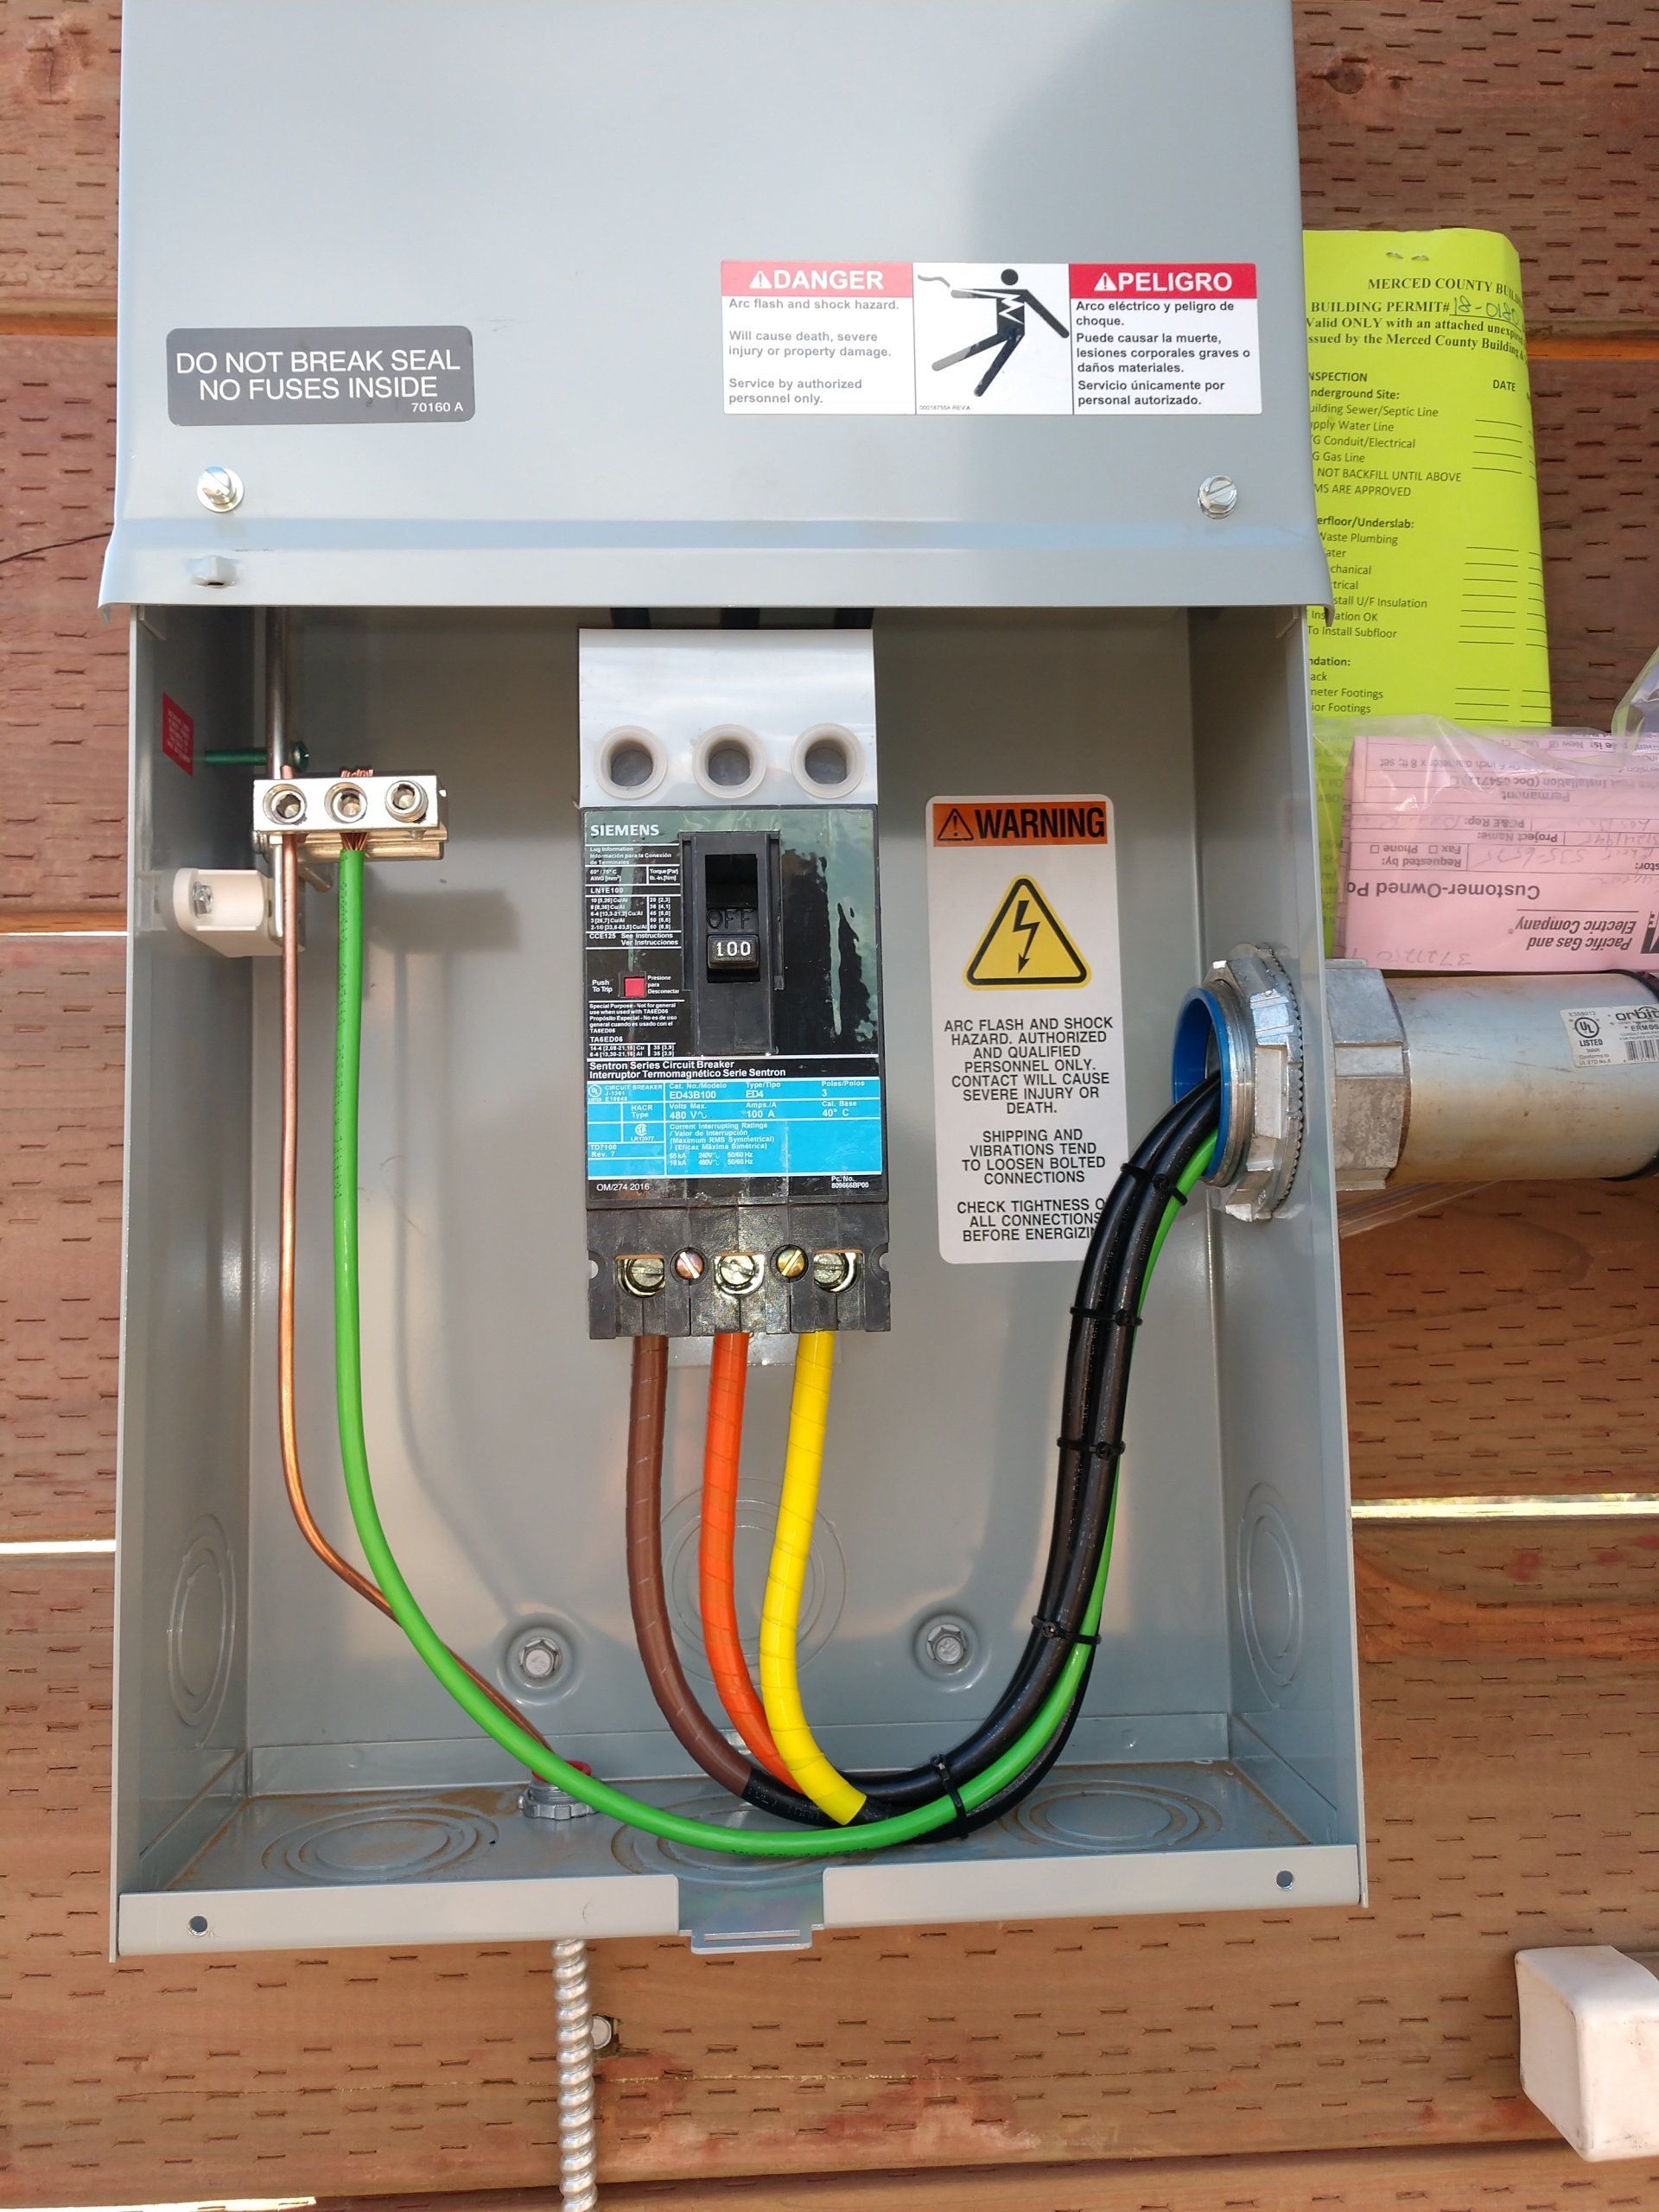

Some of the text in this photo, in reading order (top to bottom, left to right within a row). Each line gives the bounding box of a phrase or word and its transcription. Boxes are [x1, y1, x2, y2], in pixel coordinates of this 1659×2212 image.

[774, 270, 884, 290] DANGER
[1118, 272, 1233, 291] PELIGRO
[1368, 277, 1492, 293] MERCED COUNTY
[728, 298, 899, 310] Arc flash and shock hazard.
[1076, 301, 1234, 314] Arco eléctrico y peligro de
[1311, 302, 1450, 313] BUILDING PERMIT#
[1076, 316, 1124, 328] choque.
[1306, 317, 1338, 328] Valid
[1341, 317, 1382, 327] ONLY
[1386, 317, 1413, 328] with
[1417, 321, 1431, 329] an
[1435, 319, 1484, 332] attached
[729, 331, 878, 343] Will cause death, severe
[1076, 334, 1222, 345] Puede causar la muerte,
[728, 346, 763, 358] injury
[784, 346, 836, 359] property
[839, 346, 892, 359] damage.
[1308, 334, 1519, 358] ssued by the Merced County Building
[1077, 348, 1127, 358] lesiones
[1130, 348, 1195, 360] corporales
[1198, 350, 1238, 360] graves
[175, 349, 461, 373] DO NOT BREAK SEAL
[1077, 362, 1184, 372] daños materiales.
[200, 376, 438, 400] NO FUSES INSIDE
[728, 378, 862, 391] Service by authorized
[1077, 380, 1225, 392] Servicio únicamente por
[1492, 379, 1516, 391] DATE
[728, 394, 823, 406] personnel only.
[1077, 395, 1202, 407] personal autorizado.
[1311, 388, 1400, 402] nderground Site:
[411, 402, 464, 413] 70160 A
[1346, 404, 1439, 417] Sewer/Septic Line
[1338, 420, 1395, 432] Water Line
[1324, 435, 1415, 449] Conduit/Electrical
[1323, 452, 1365, 463] Gas Line
[1317, 467, 1462, 482] NOT BACKFILL UNTIL ABOVE
[1332, 484, 1351, 494] ARE
[1355, 485, 1411, 497] APPROVED
[1351, 533, 1398, 546] Plumbing
[1377, 598, 1427, 608] Insulation
[1363, 612, 1378, 621] OK
[1307, 625, 1397, 639] To Install Subfloor
[1341, 688, 1383, 701] Footings
[590, 824, 660, 836] SIEMENS
[975, 808, 1105, 839] WARNING
[1478, 831, 1558, 843] Project Name:
[1382, 843, 1462, 855] Fax Phone
[1382, 855, 1462, 868] Requested by:
[1376, 882, 1541, 900] Customer-Owned
[706, 908, 754, 930] OFF
[1516, 916, 1637, 935] Electric Company
[716, 941, 751, 957] 100
[1527, 937, 1633, 951] Pacific Gas and
[944, 1016, 1114, 1032] ARC FLASH AND SHOCK
[951, 1031, 1107, 1046] HAZARD. AUTHORIZED
[973, 1046, 1081, 1059] AND QUALIFIED
[589, 1062, 628, 1071] Sentron
[630, 1062, 660, 1071] Series
[696, 1060, 734, 1069] Breaker
[964, 1059, 1096, 1073] PERSONNEL ONLY.
[589, 1071, 640, 1080] Interruptor
[642, 1069, 721, 1080] Termomagnético
[951, 1072, 1109, 1087] CONTACT WILL CAUSE
[963, 1086, 1099, 1101] SEVERE INJURY OR
[1007, 1102, 1057, 1114] DEATH.
[982, 1128, 1083, 1142] SHIPPING AND
[969, 1142, 1096, 1157] VIBRATIONS TEND
[962, 1156, 1105, 1172] TO LOOSEN BOLTED
[984, 1171, 1084, 1185] CONNECTIONS
[957, 1198, 1090, 1214] CHECK TIGHTNESS
[969, 1212, 1100, 1227] ALL CONNECTIONS
[963, 1229, 1020, 1242] BEFORE
